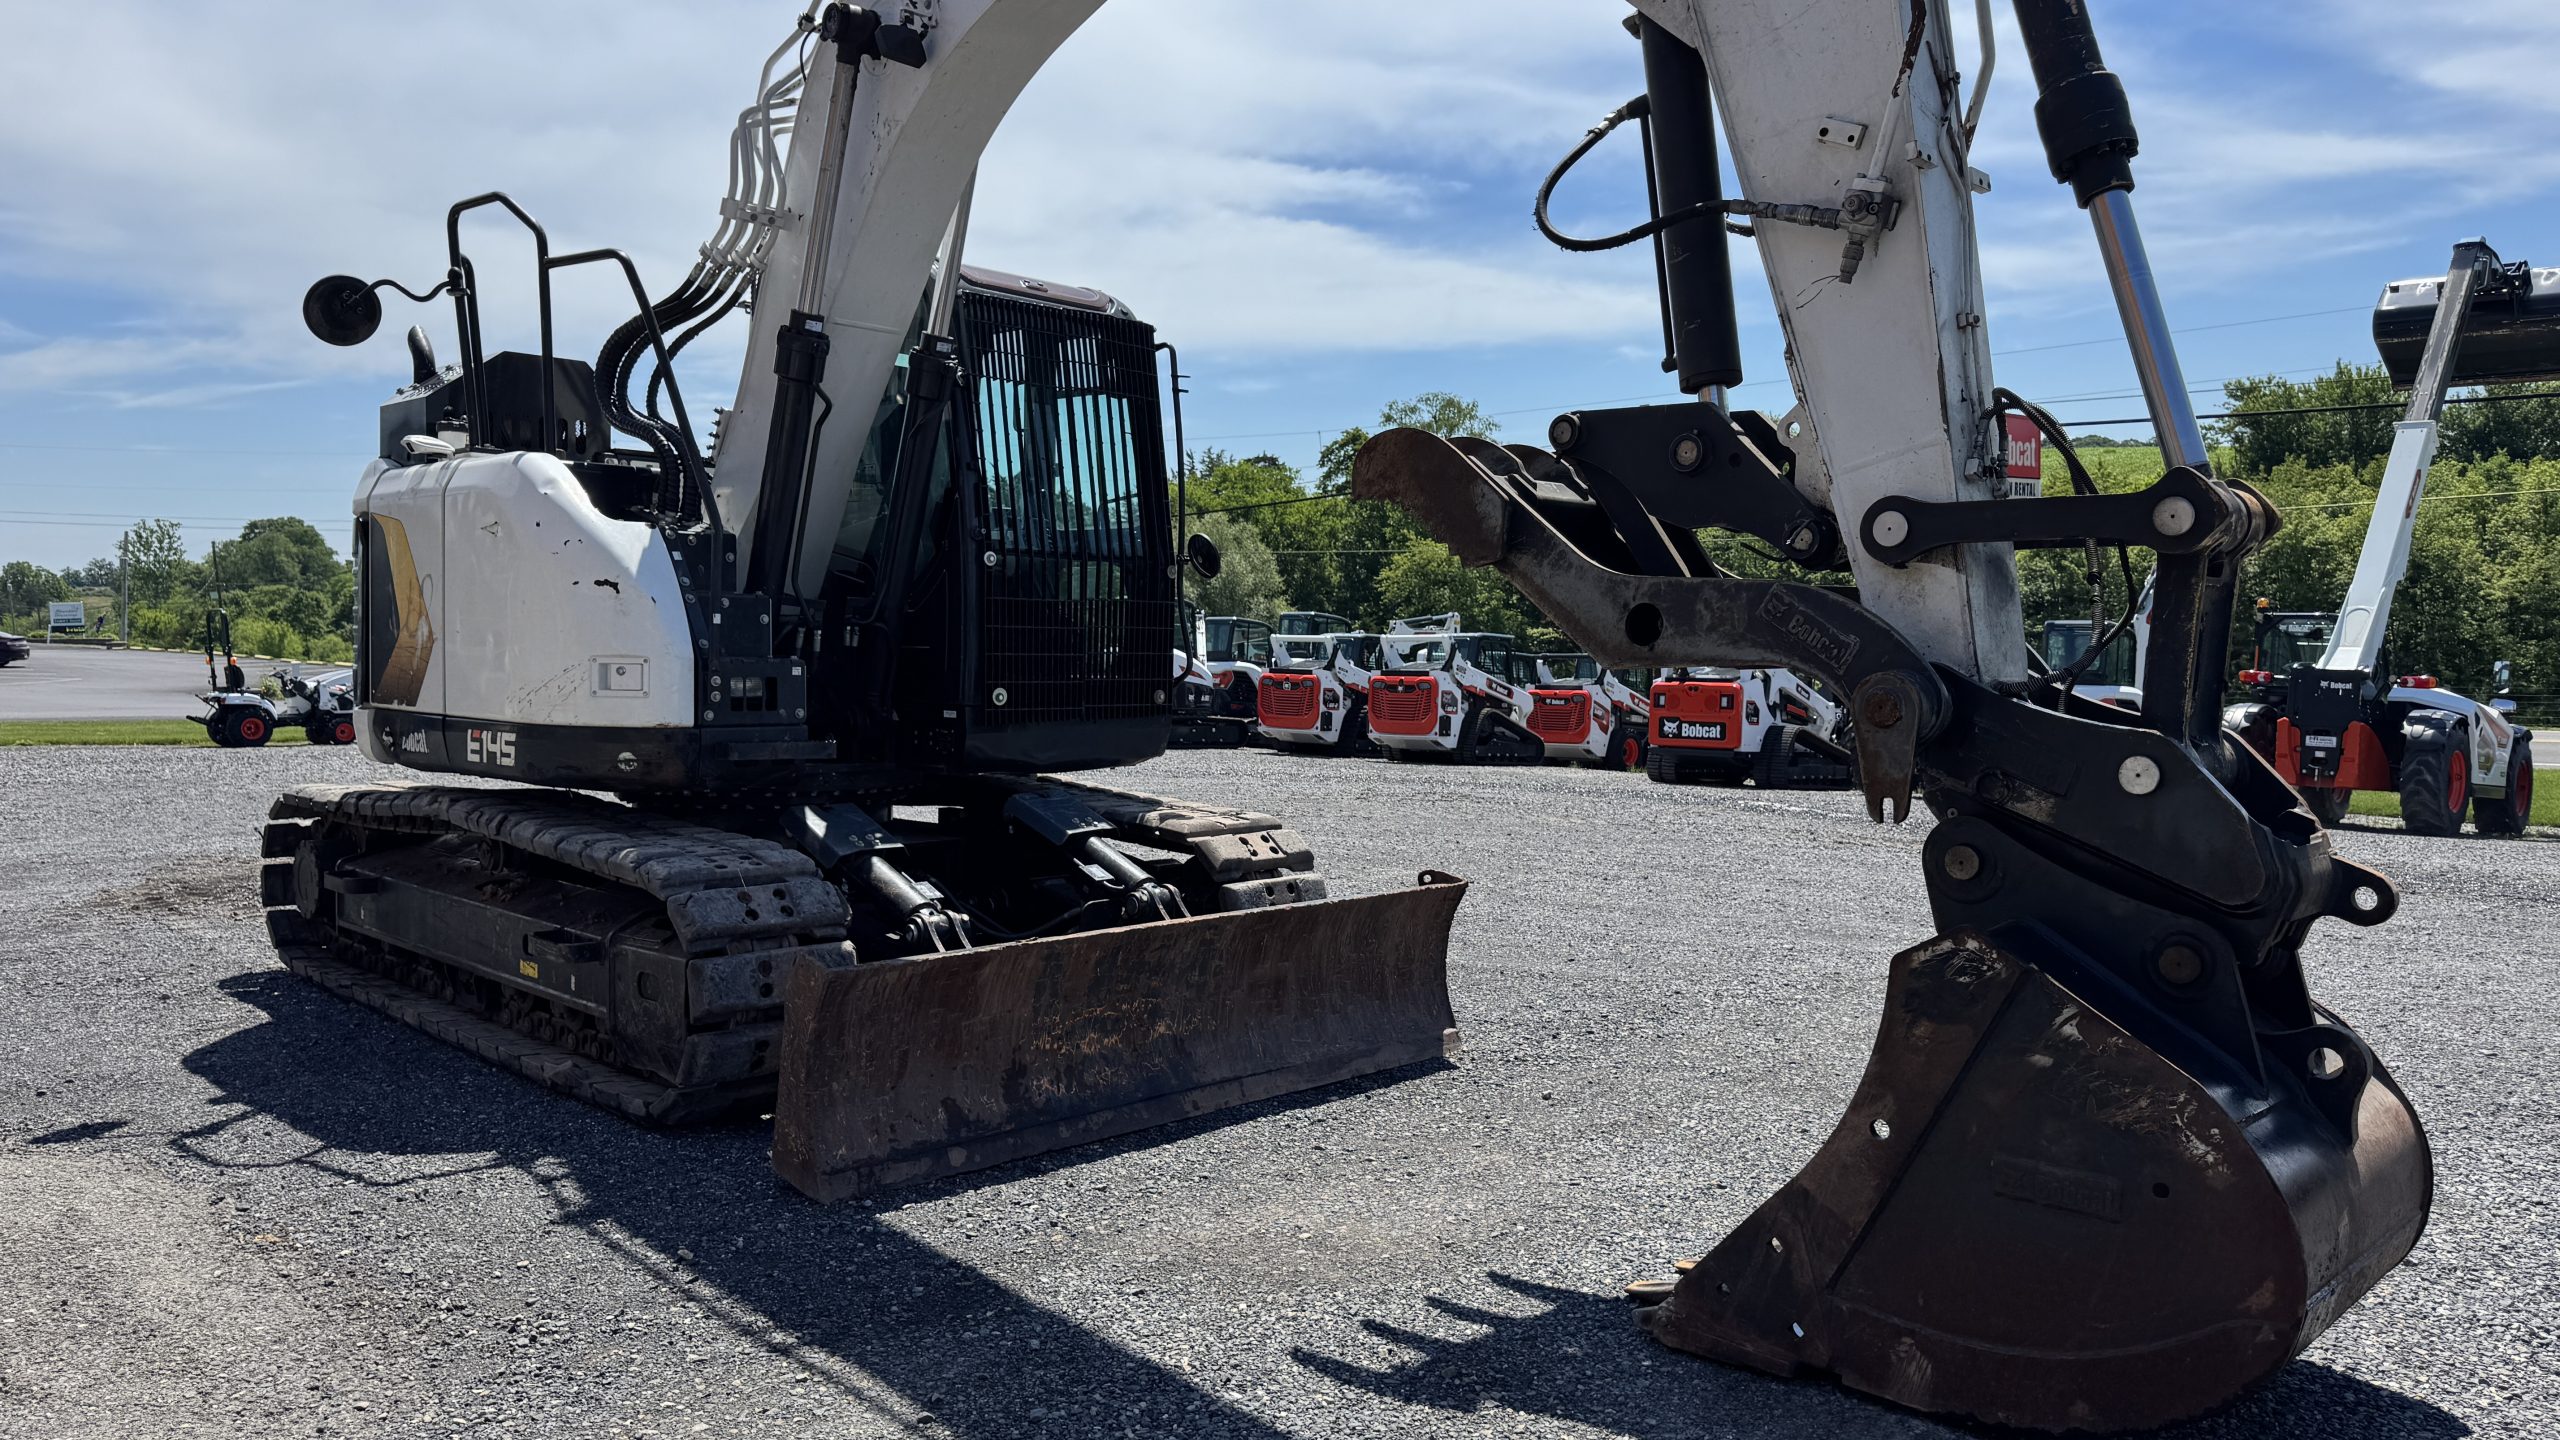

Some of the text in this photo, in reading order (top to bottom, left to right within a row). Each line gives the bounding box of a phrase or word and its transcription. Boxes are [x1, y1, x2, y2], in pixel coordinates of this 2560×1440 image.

[2008, 434, 2036, 467] bcat
[2014, 482, 2036, 497] RENTAL
[1681, 722, 1721, 739] Bobcat
[466, 728, 517, 767] E145
